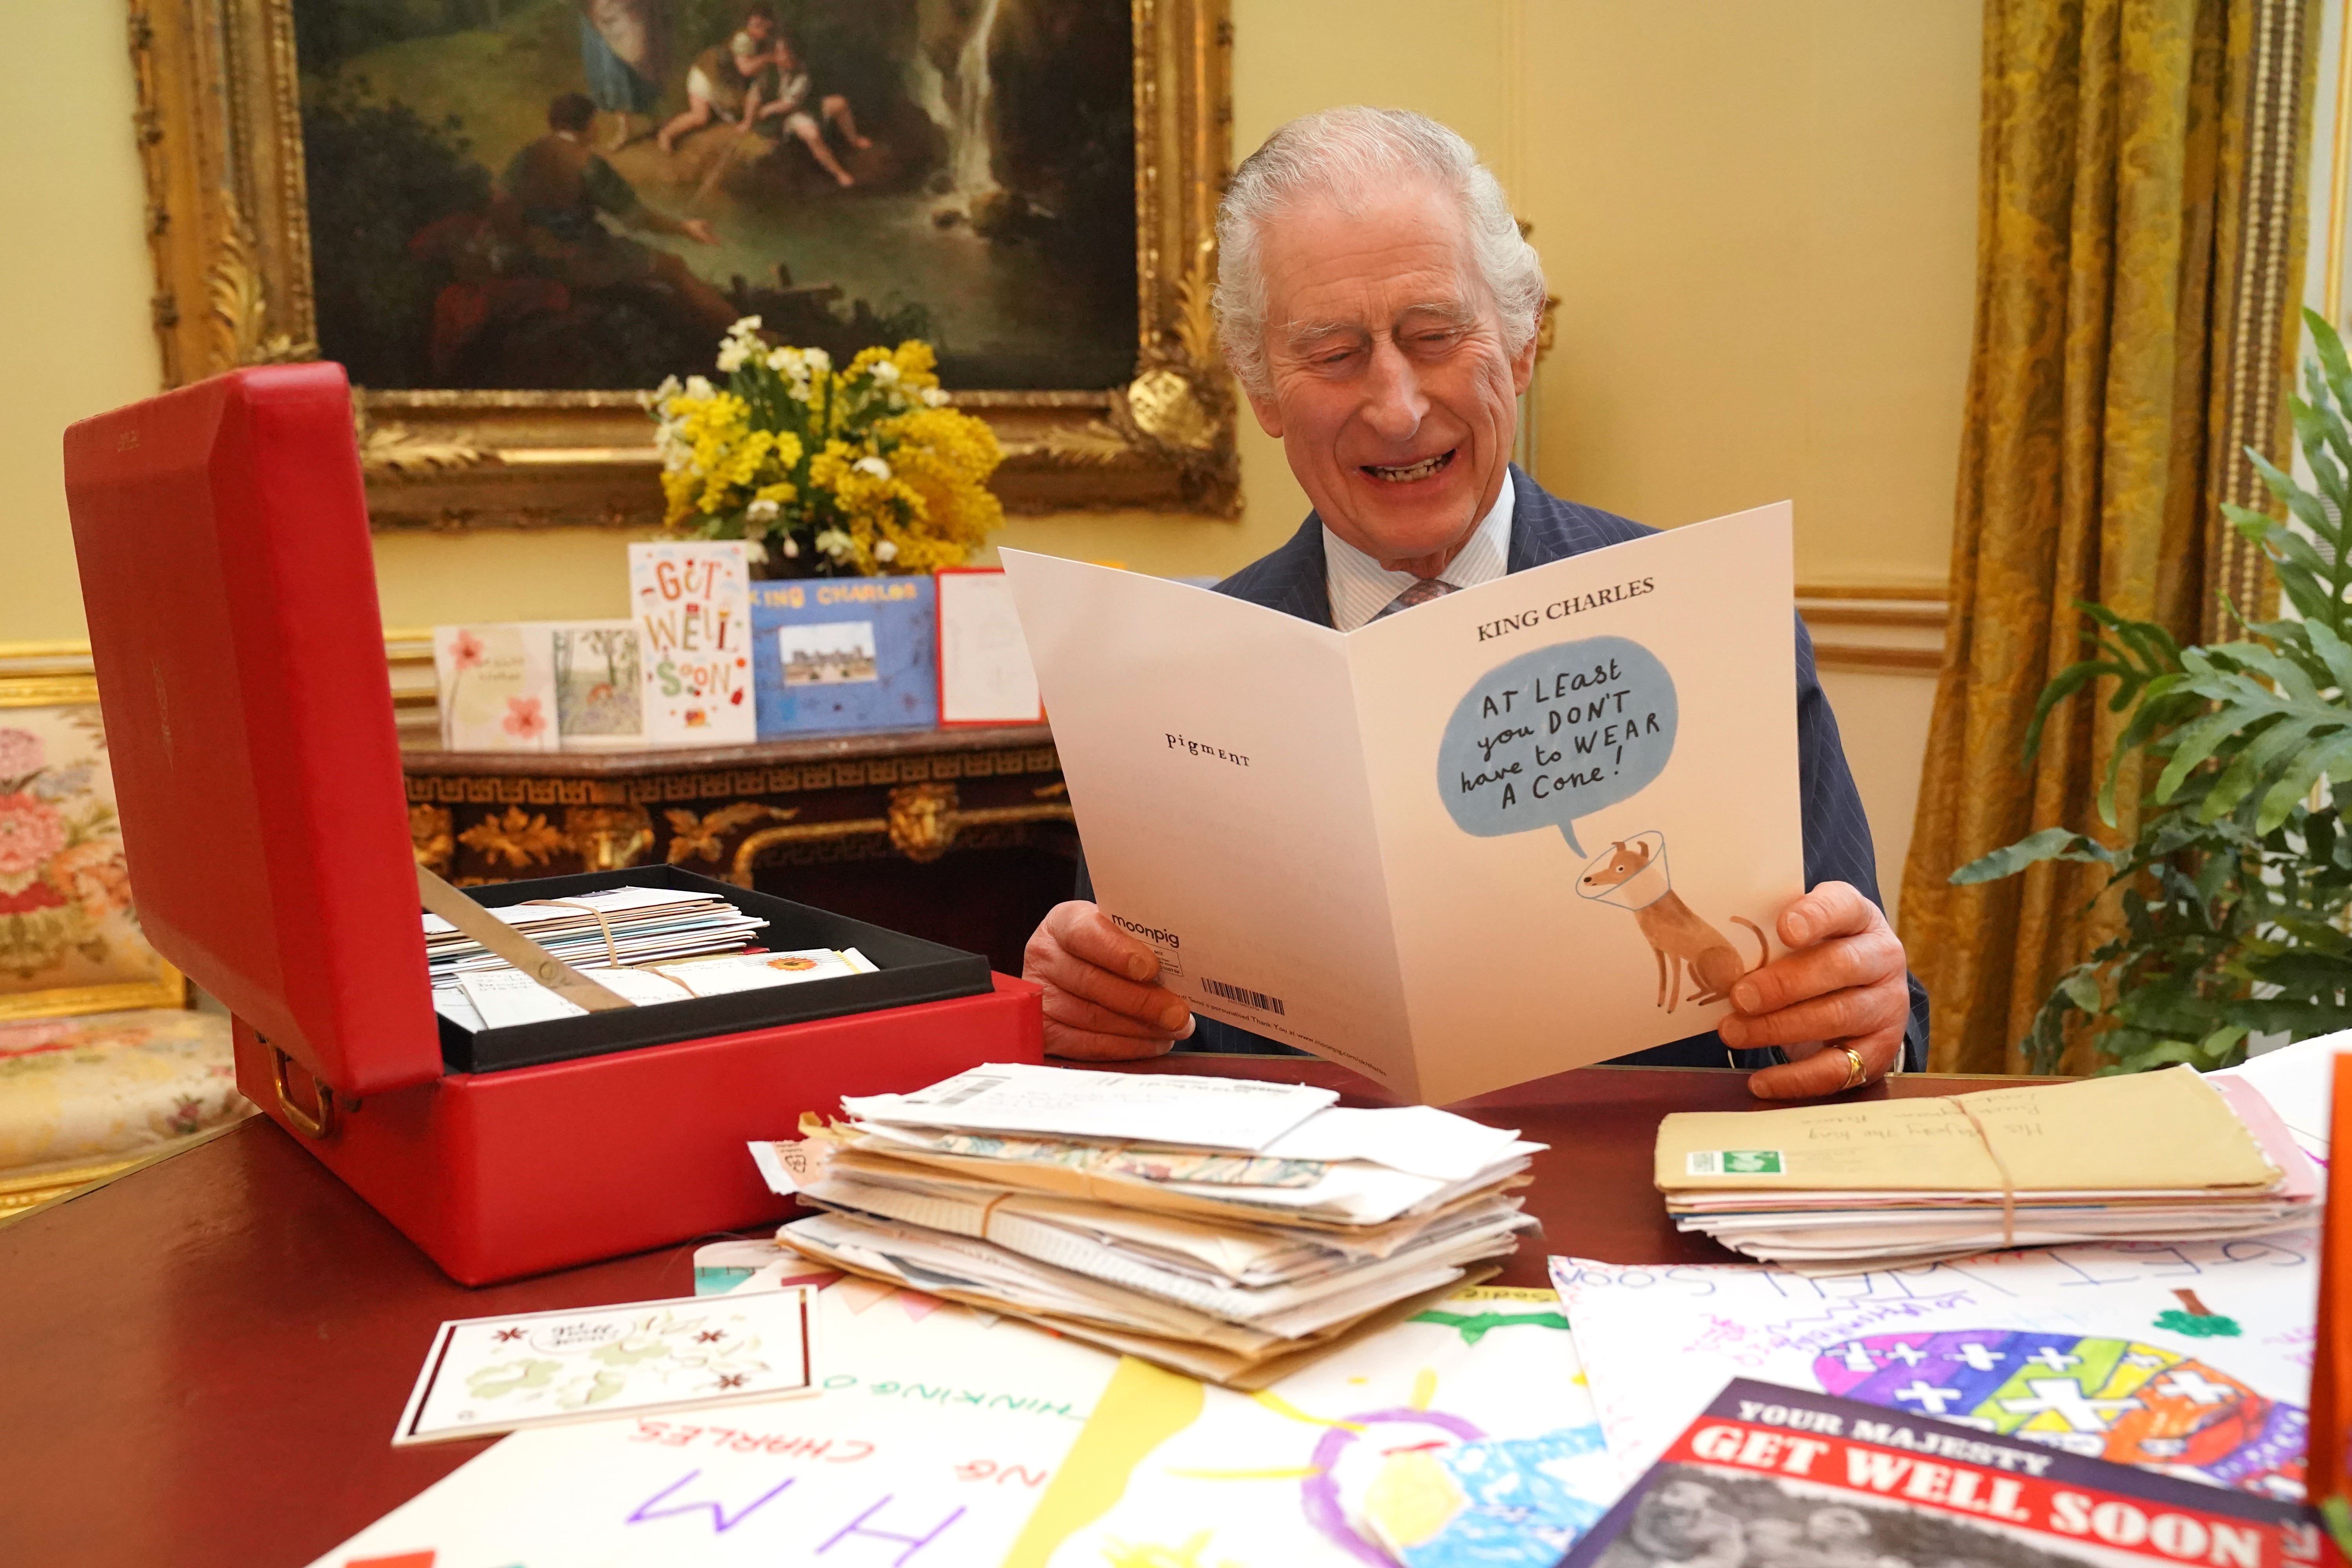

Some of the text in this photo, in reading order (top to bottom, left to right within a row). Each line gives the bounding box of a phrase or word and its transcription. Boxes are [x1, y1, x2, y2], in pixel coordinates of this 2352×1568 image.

[657, 561, 722, 601] GET
[644, 606, 738, 652] WELL
[1477, 577, 1655, 642] KING CHARLES
[657, 661, 731, 697] SOON
[1483, 690, 1518, 718] AT
[1477, 690, 1631, 762] you DON'T
[1461, 712, 1660, 793] have to WEAR
[1503, 784, 1516, 809] A
[1112, 915, 1180, 948] moonpig
[1189, 996, 1204, 1006] Send
[1211, 1004, 1249, 1021] personalised
[1251, 1015, 1272, 1028] Thank
[1273, 1023, 1287, 1033] You
[2047, 1240, 2307, 1287] GET
[824, 1375, 858, 1390] O
[1738, 1399, 2053, 1477] YOUR MAJESTY
[954, 1459, 1049, 1488] NG
[1690, 1424, 1829, 1475] GET
[1844, 1446, 2031, 1522] WELL
[2049, 1489, 2265, 1568] SOON
